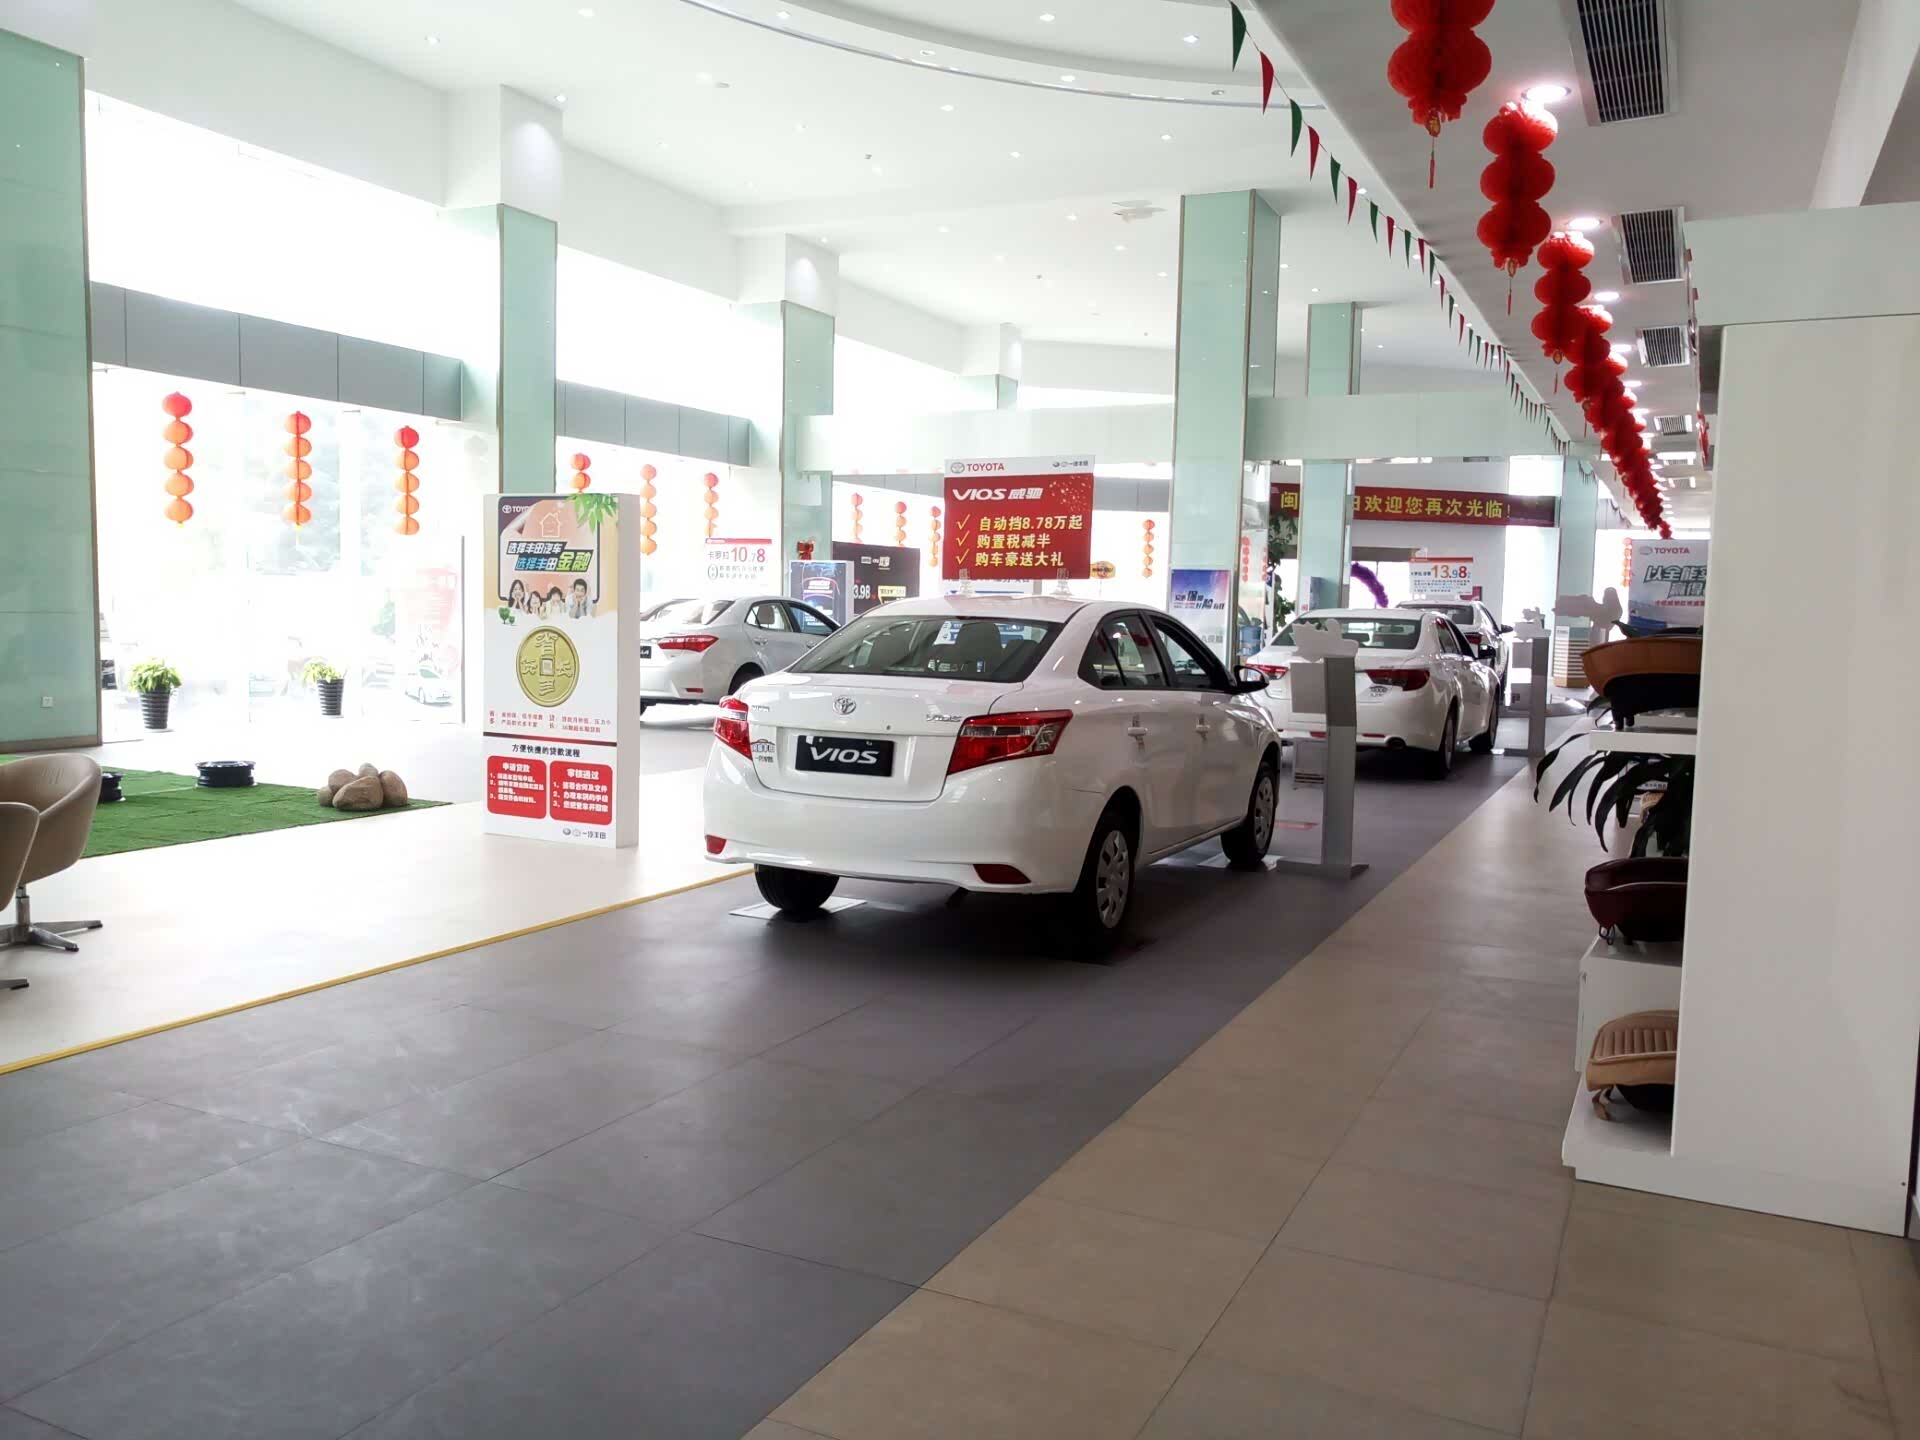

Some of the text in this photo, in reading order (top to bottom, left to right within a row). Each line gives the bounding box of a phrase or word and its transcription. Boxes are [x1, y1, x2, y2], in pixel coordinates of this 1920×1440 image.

[966, 463, 1005, 472] TOYOTA
[952, 487, 1044, 501] VIOS 威驰
[979, 514, 1083, 531] 自动挡8.78万起
[507, 542, 563, 555] 选择丰田汽车
[976, 532, 1051, 549] 购置税减半
[515, 551, 592, 571] 选择丰田金融
[974, 551, 1064, 567] 购车豪送大礼
[809, 745, 881, 766] VIOS
